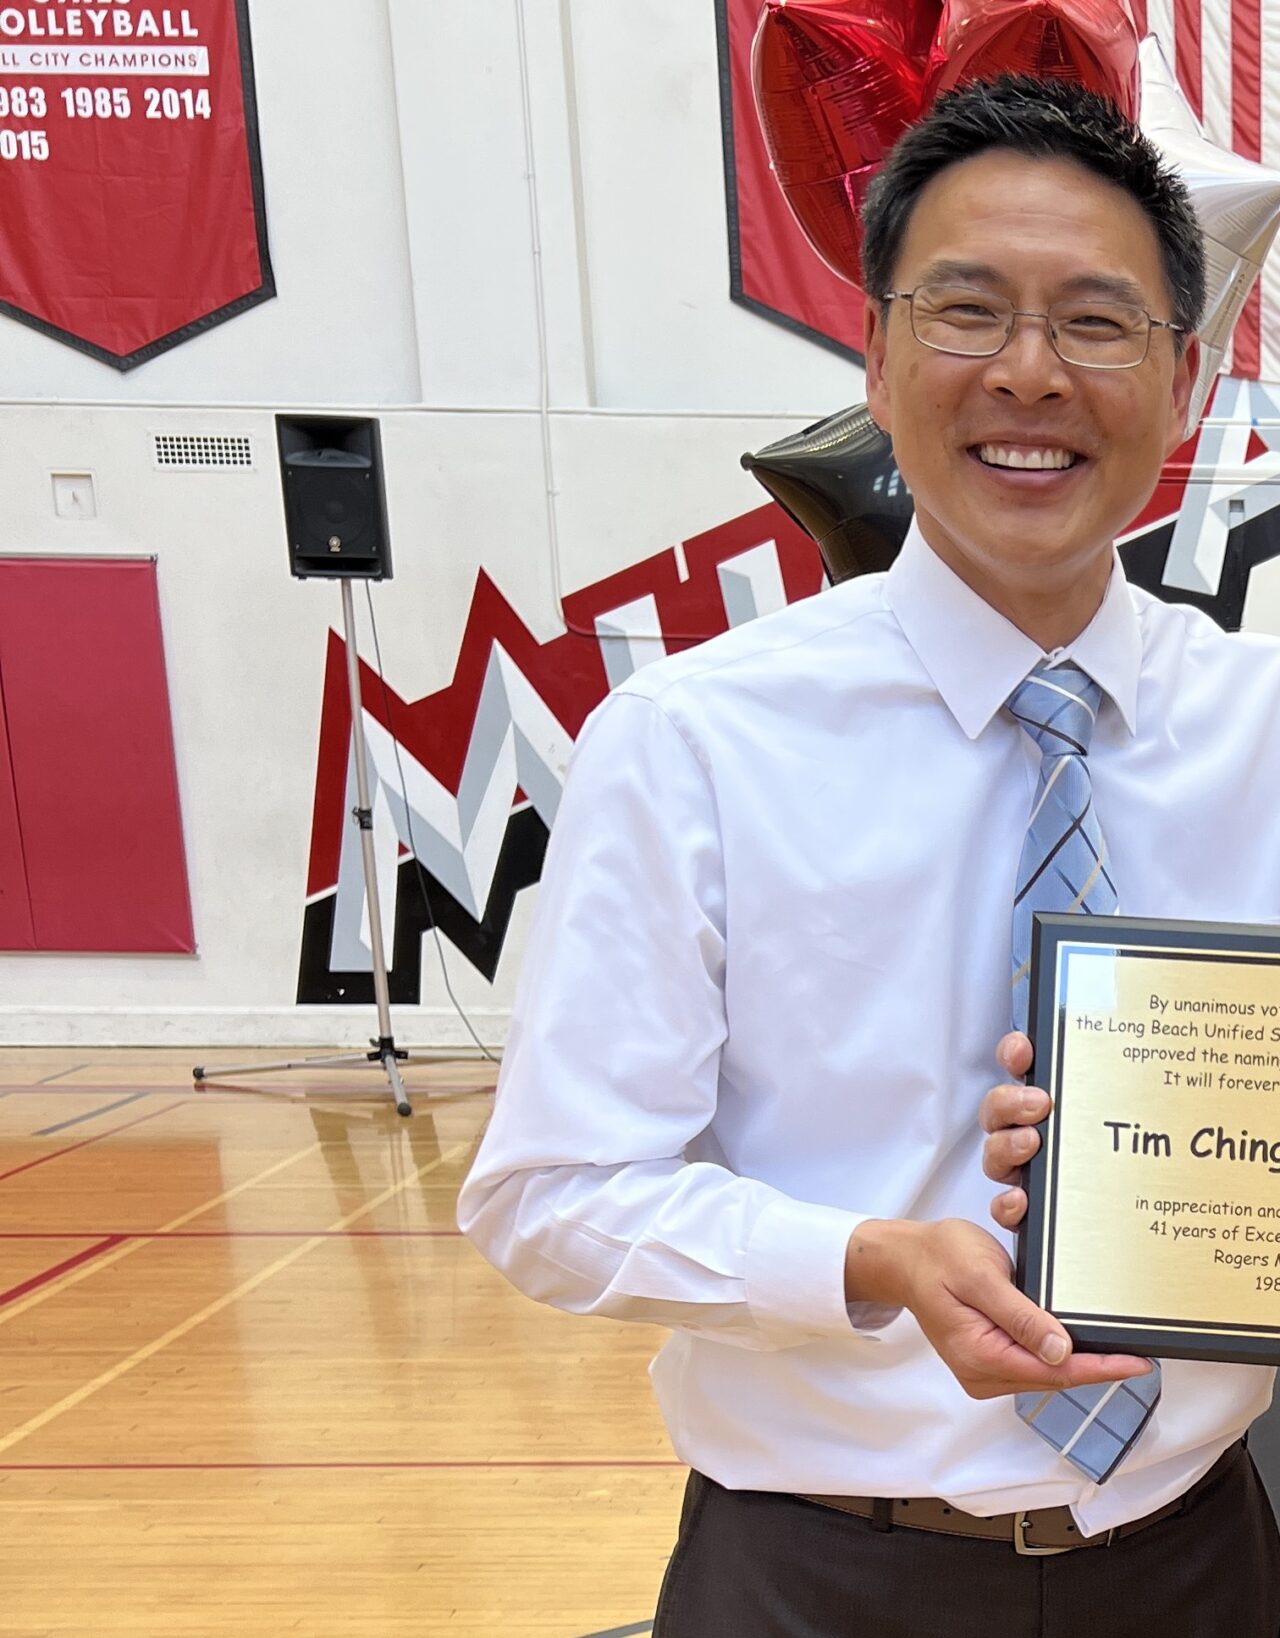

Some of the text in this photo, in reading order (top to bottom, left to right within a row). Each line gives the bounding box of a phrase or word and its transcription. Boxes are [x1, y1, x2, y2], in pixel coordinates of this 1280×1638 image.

[0, 9, 199, 37] OLLEYBALL
[2, 53, 197, 68] LL CITY CHAMPIONS
[0, 86, 212, 120] 983 1985 2014
[0, 129, 50, 161] 015
[1149, 993, 1170, 1016] By
[1174, 998, 1256, 1016] unanimous
[1075, 1015, 1104, 1032] the
[1108, 1016, 1146, 1039] Long
[1151, 1018, 1199, 1038] Beach
[1204, 1022, 1265, 1042] Unified
[1122, 1046, 1197, 1064] approved
[1200, 1047, 1230, 1065] the
[1163, 1069, 1182, 1087] It
[1186, 1071, 1213, 1089] will
[1217, 1072, 1280, 1093] forever
[1102, 1120, 1172, 1158] Tim
[1135, 1195, 1149, 1211] in
[1153, 1199, 1253, 1218] appreciation
[1148, 1219, 1168, 1236] 41
[1171, 1225, 1217, 1242] years
[1221, 1224, 1241, 1242] of
[1213, 1248, 1270, 1270] Rogers
